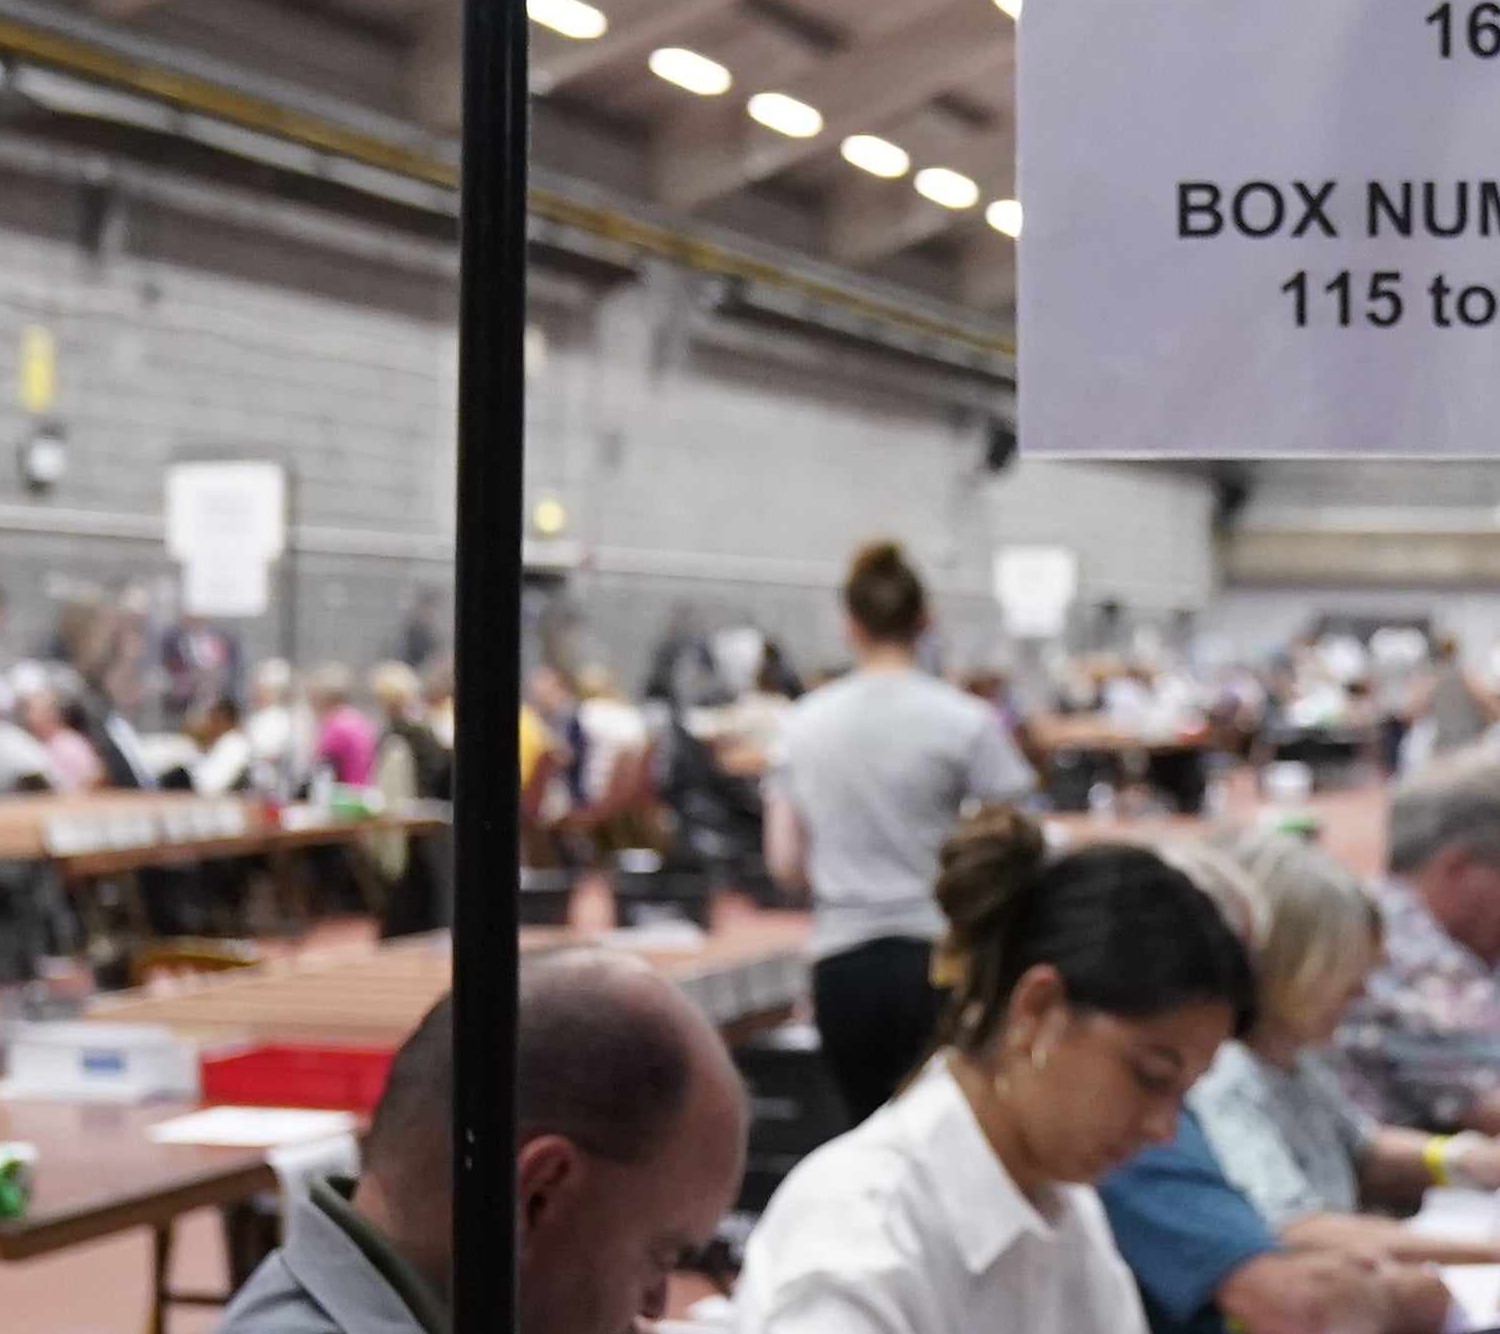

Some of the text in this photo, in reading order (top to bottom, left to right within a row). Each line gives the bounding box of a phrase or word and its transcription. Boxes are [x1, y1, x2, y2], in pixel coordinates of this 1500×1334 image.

[1176, 179, 1340, 241] BOX
[1280, 267, 1406, 330] 115
[1426, 272, 1500, 330] to
